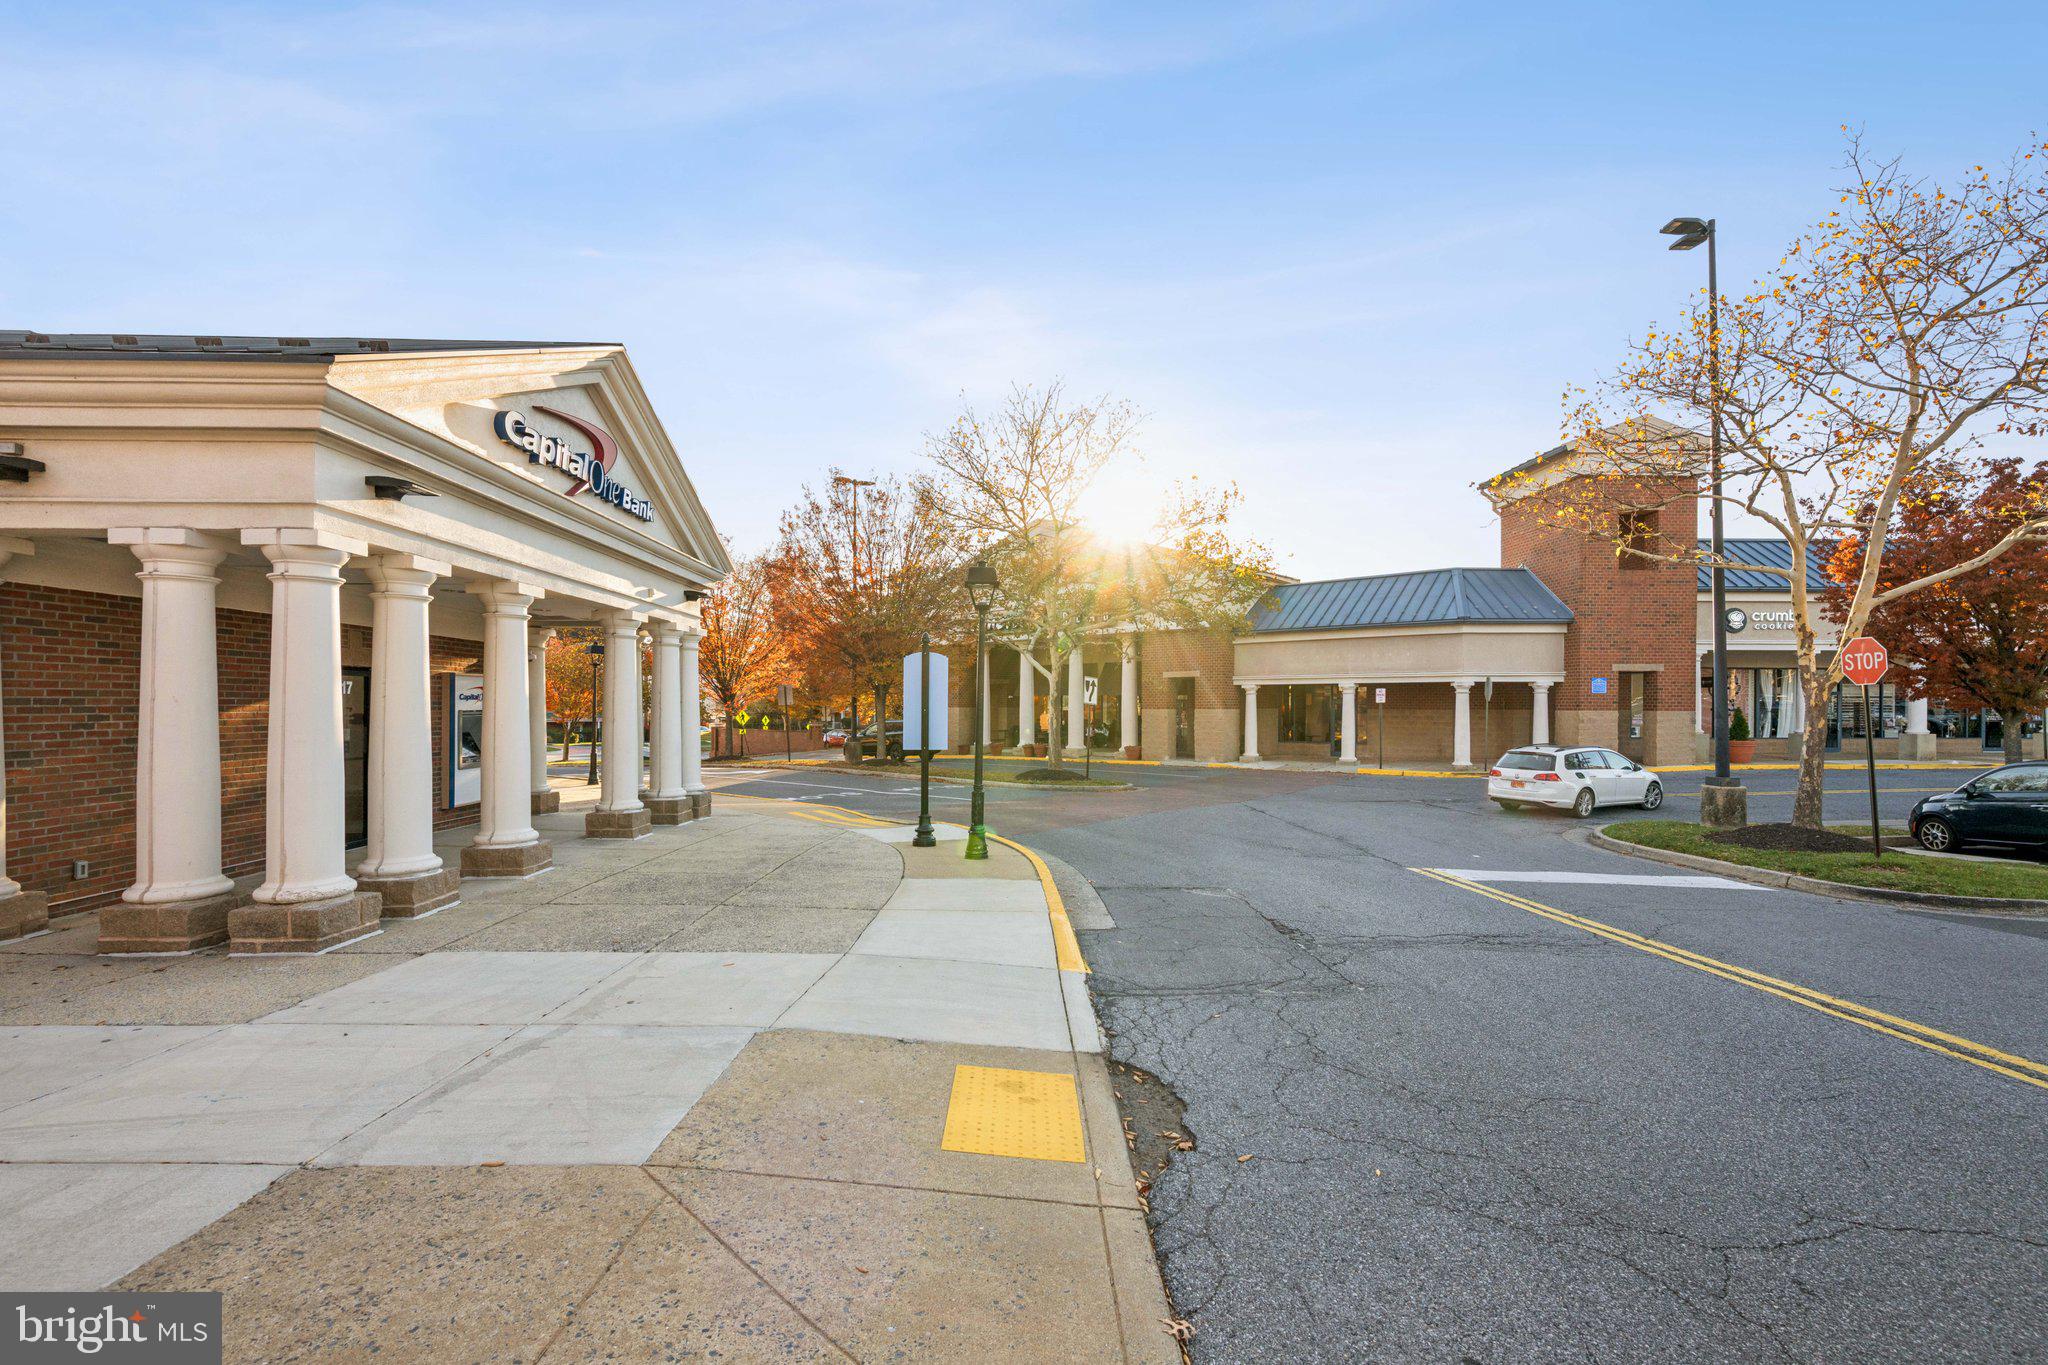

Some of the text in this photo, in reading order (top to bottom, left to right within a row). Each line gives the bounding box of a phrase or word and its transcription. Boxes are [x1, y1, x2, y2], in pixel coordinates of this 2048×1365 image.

[494, 411, 654, 522] Capital One Bank
[1844, 651, 1884, 671] STOP
